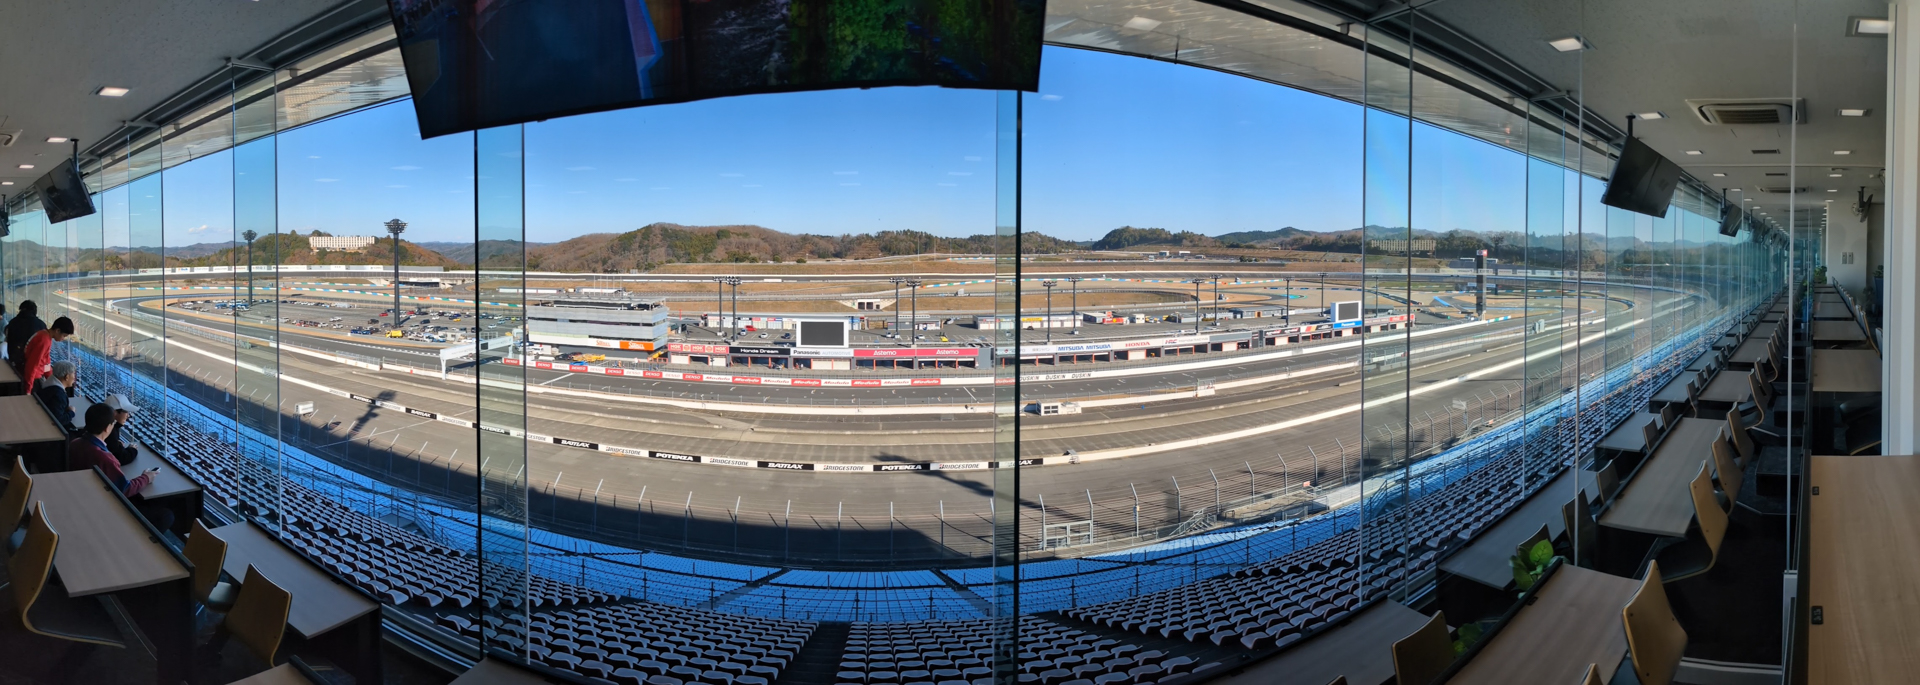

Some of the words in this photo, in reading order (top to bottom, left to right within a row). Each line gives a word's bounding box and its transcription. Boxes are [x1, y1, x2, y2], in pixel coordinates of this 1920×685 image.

[353, 395, 372, 403] POTENZA
[561, 439, 590, 448] BATTLAX
[606, 446, 641, 455] BRIDGESTONE
[656, 452, 693, 461] POTENZA
[709, 458, 749, 467] BRIDGESTONE
